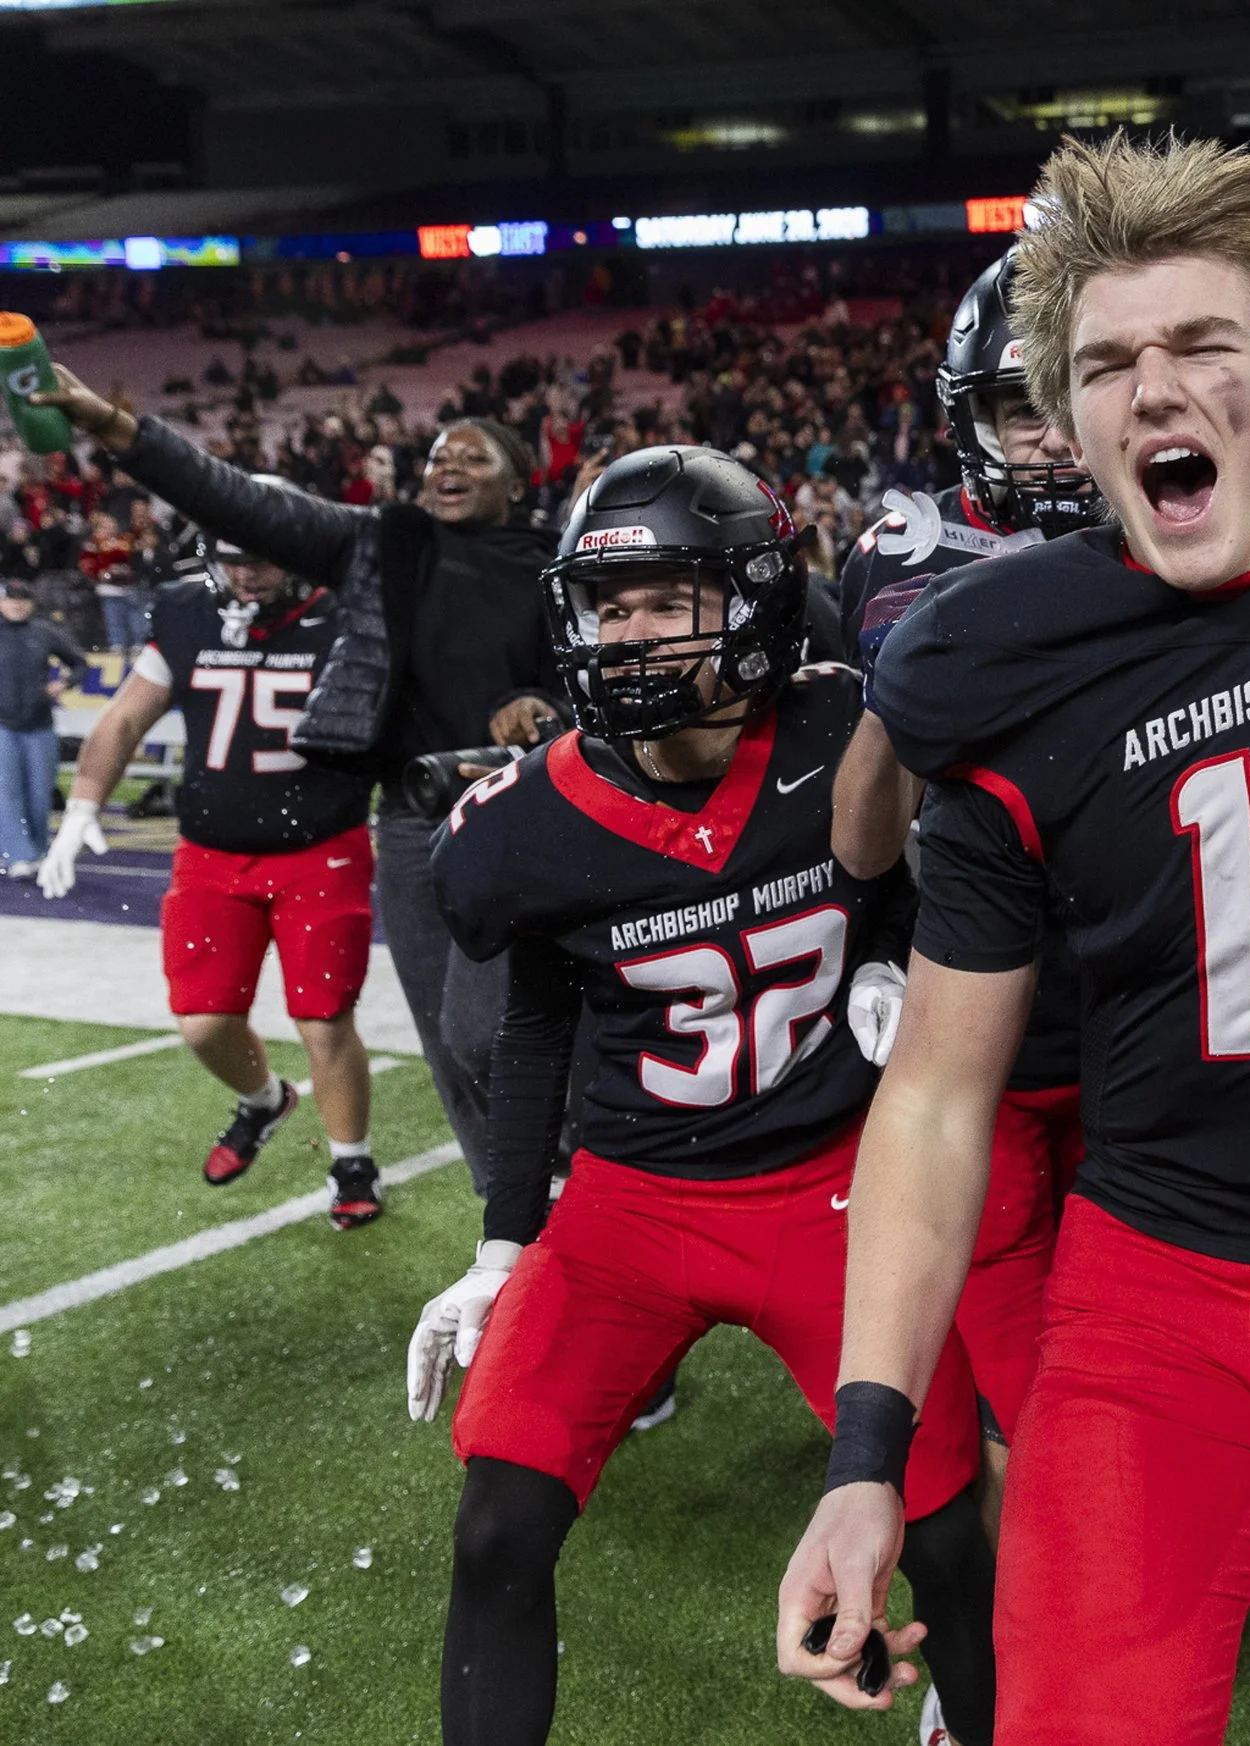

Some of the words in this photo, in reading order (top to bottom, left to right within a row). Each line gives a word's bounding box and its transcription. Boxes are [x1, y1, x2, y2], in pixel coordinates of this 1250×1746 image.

[189, 666, 313, 775] 75
[611, 892, 740, 951] ARCHBISHOP
[752, 859, 834, 915] MURPHY
[614, 903, 850, 1109] 32
